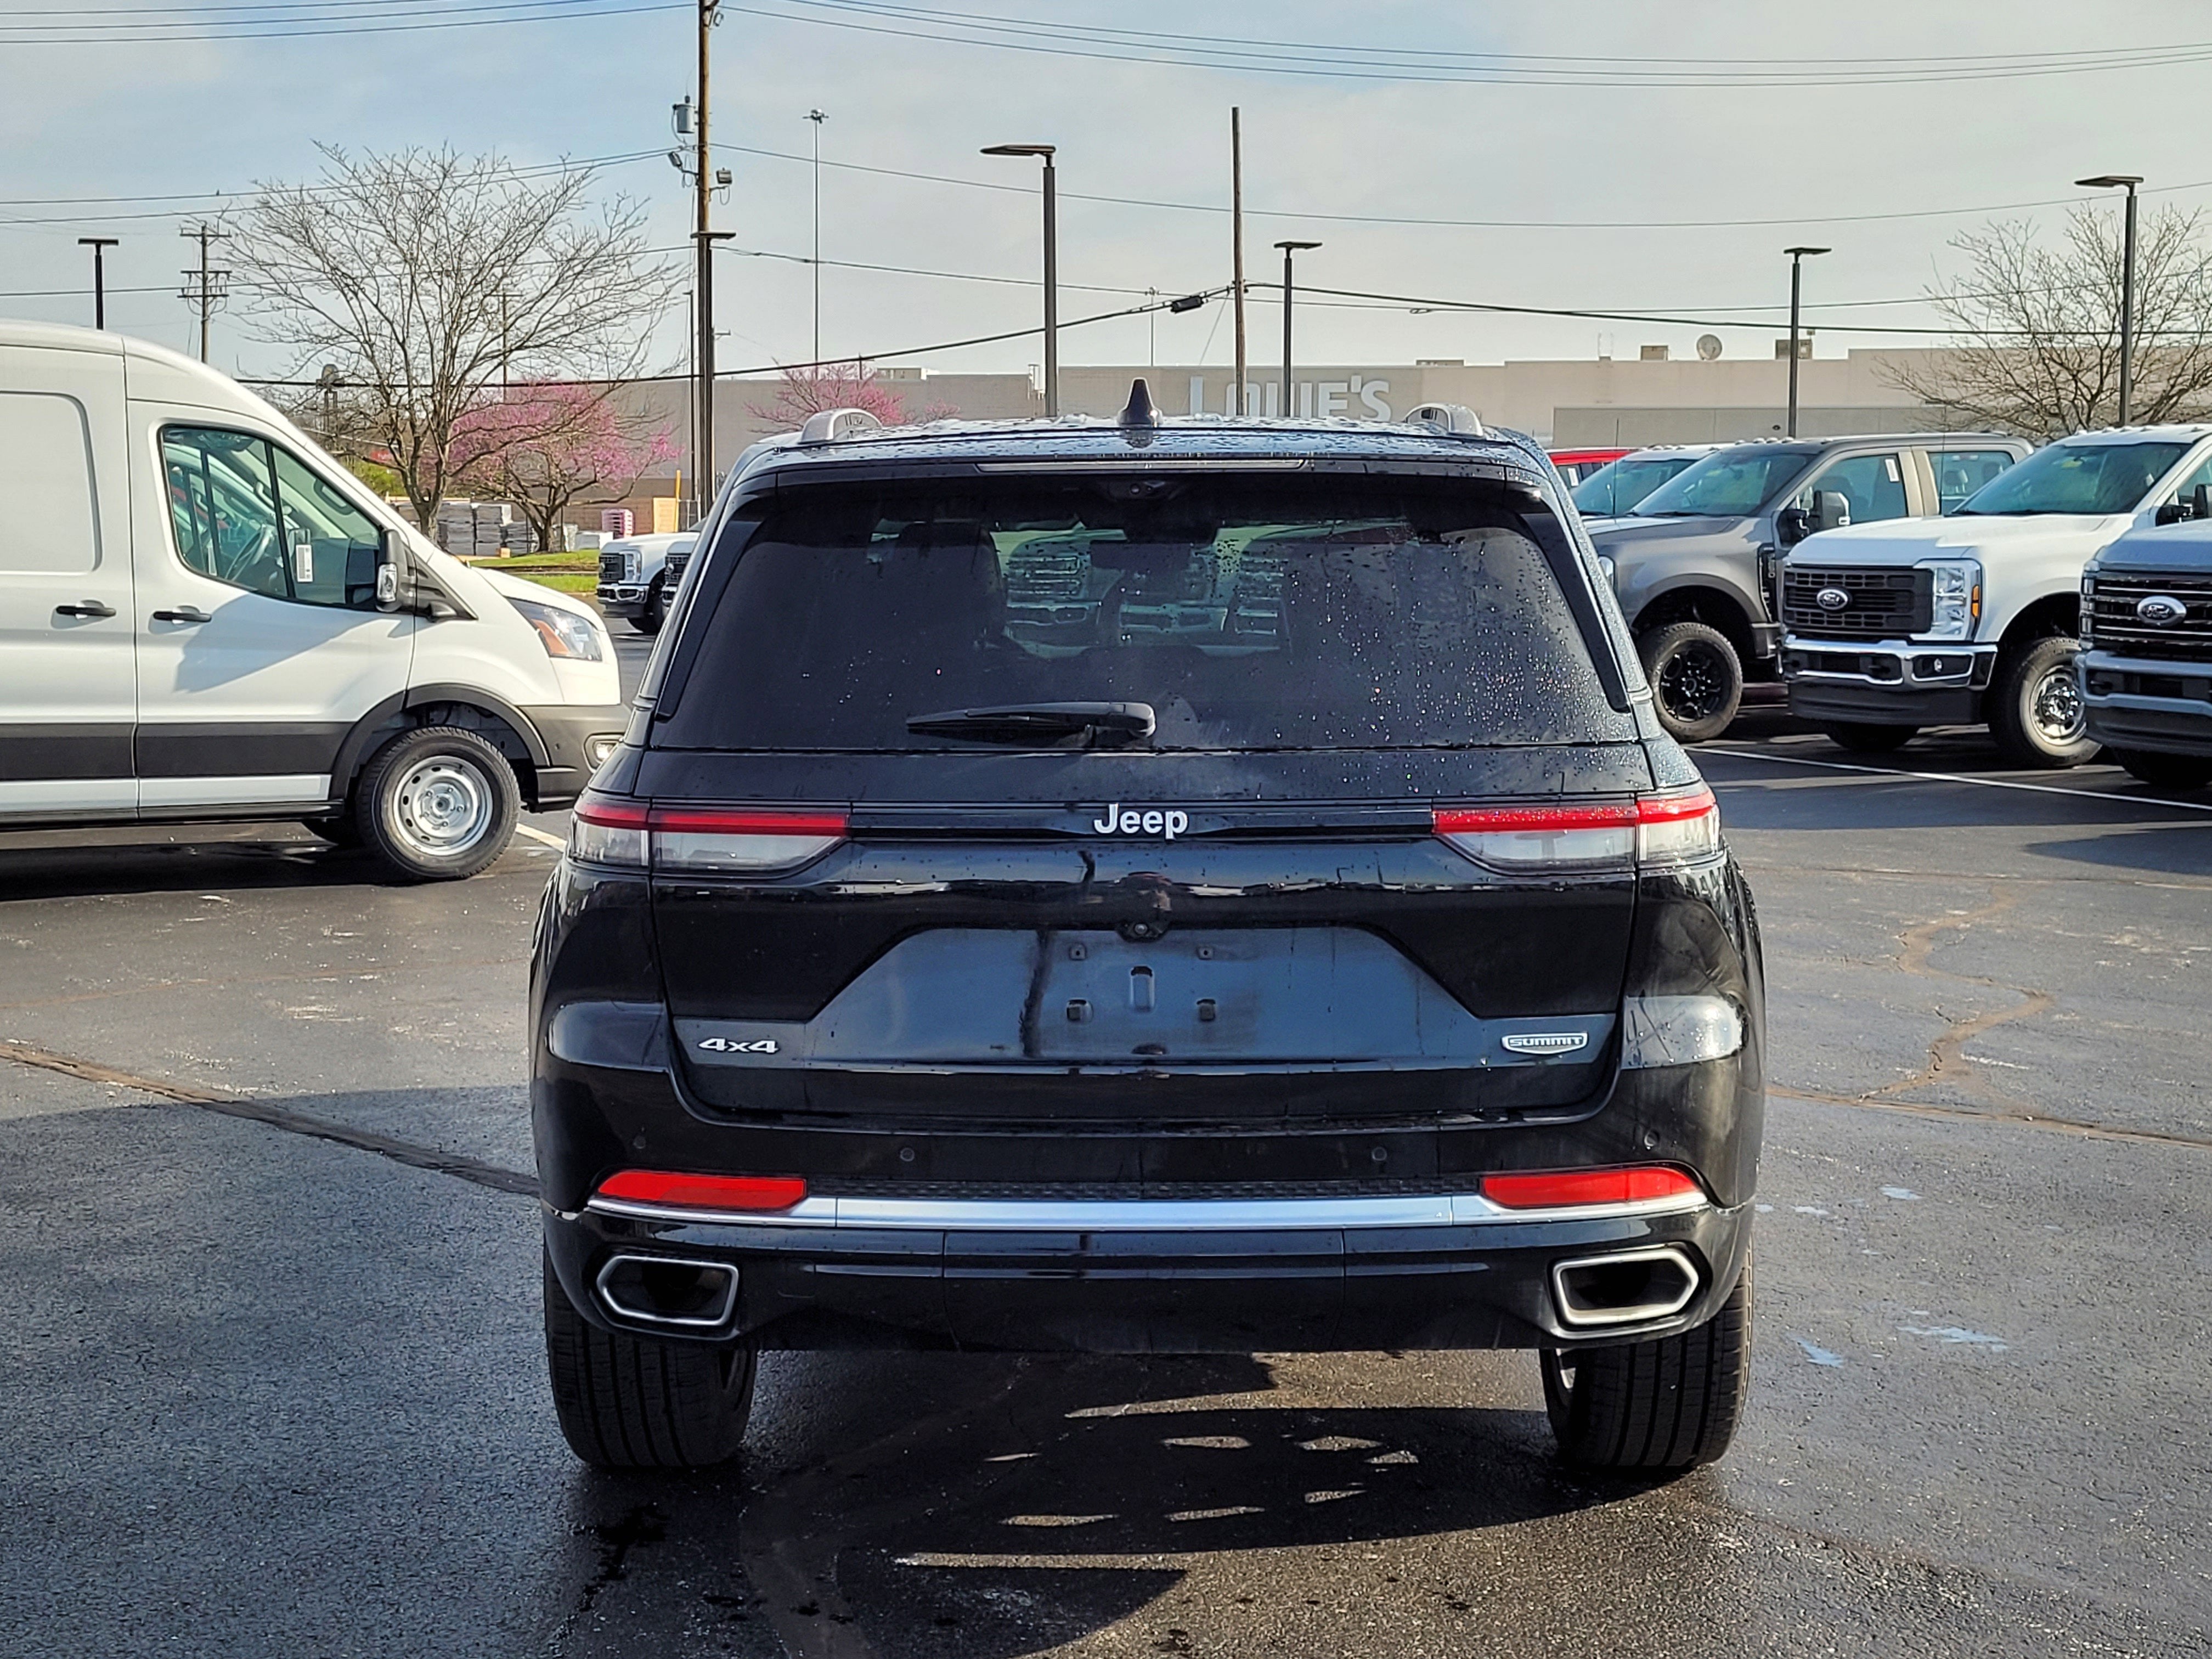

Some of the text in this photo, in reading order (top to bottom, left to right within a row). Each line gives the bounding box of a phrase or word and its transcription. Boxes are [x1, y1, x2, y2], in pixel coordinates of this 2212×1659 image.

[1093, 803, 1188, 840] Jeep
[698, 1037, 780, 1053] 4x4
[1509, 1036, 1582, 1047] SUMMIT
